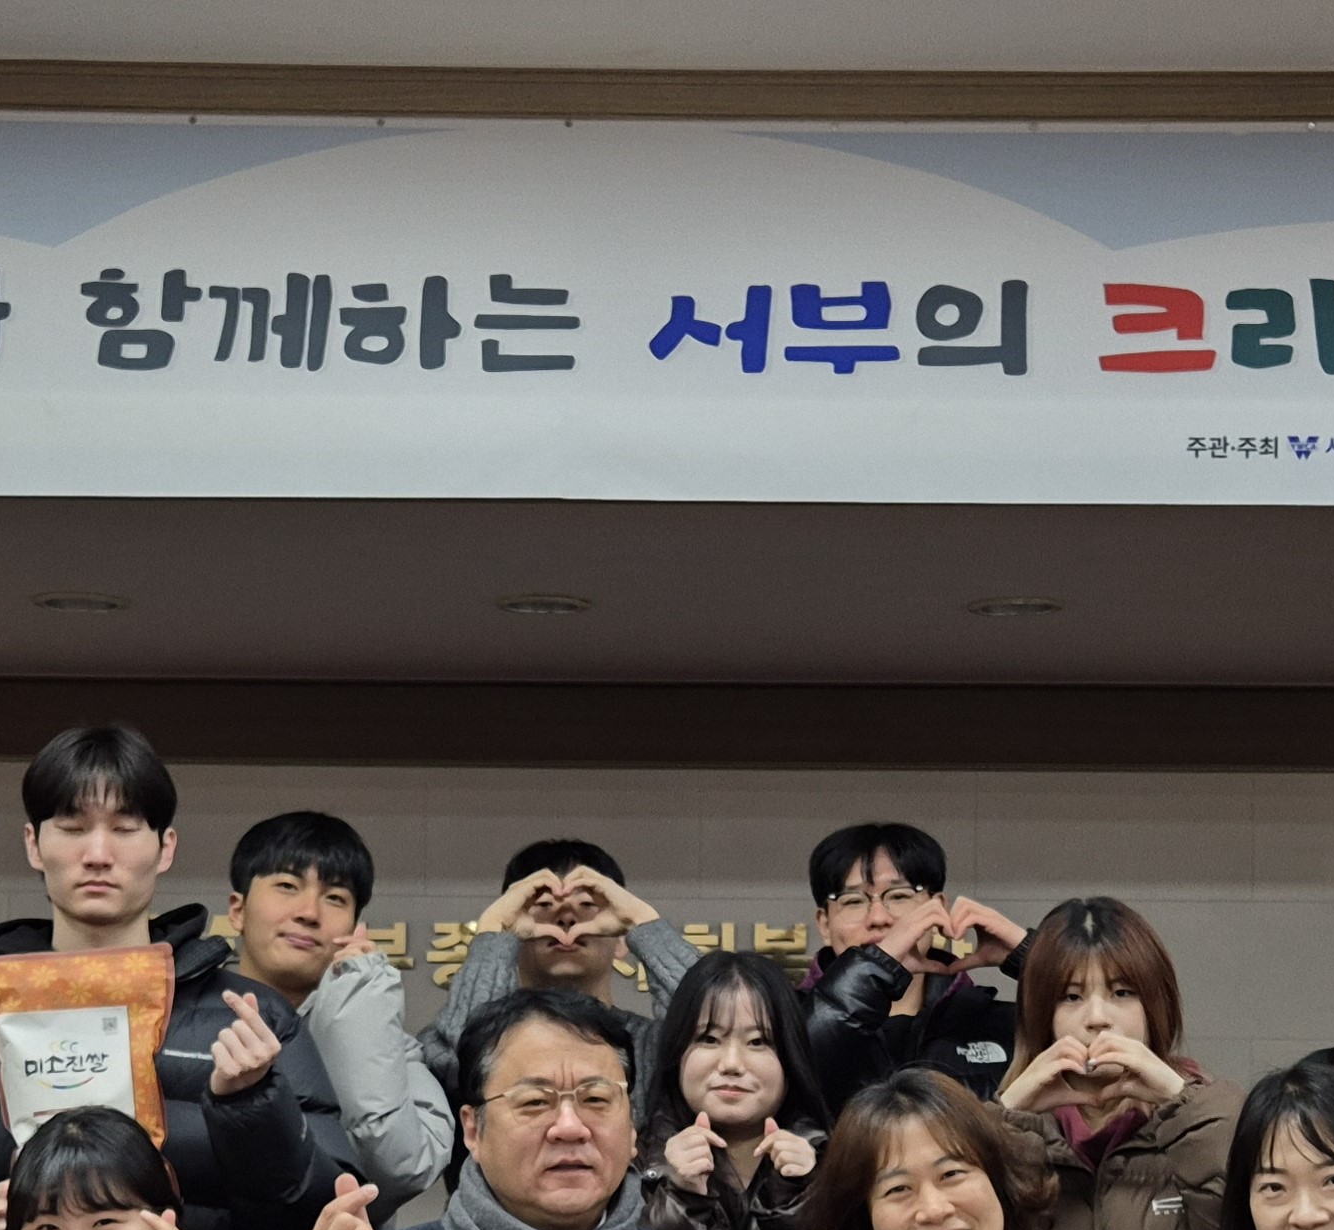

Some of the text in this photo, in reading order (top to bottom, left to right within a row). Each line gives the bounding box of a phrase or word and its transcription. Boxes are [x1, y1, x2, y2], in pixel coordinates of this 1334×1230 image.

[79, 267, 581, 373] 함께하는
[648, 279, 1030, 377] 서부의
[1186, 435, 1279, 459] 주관·주최
[24, 1053, 109, 1078] 미소진쌀
